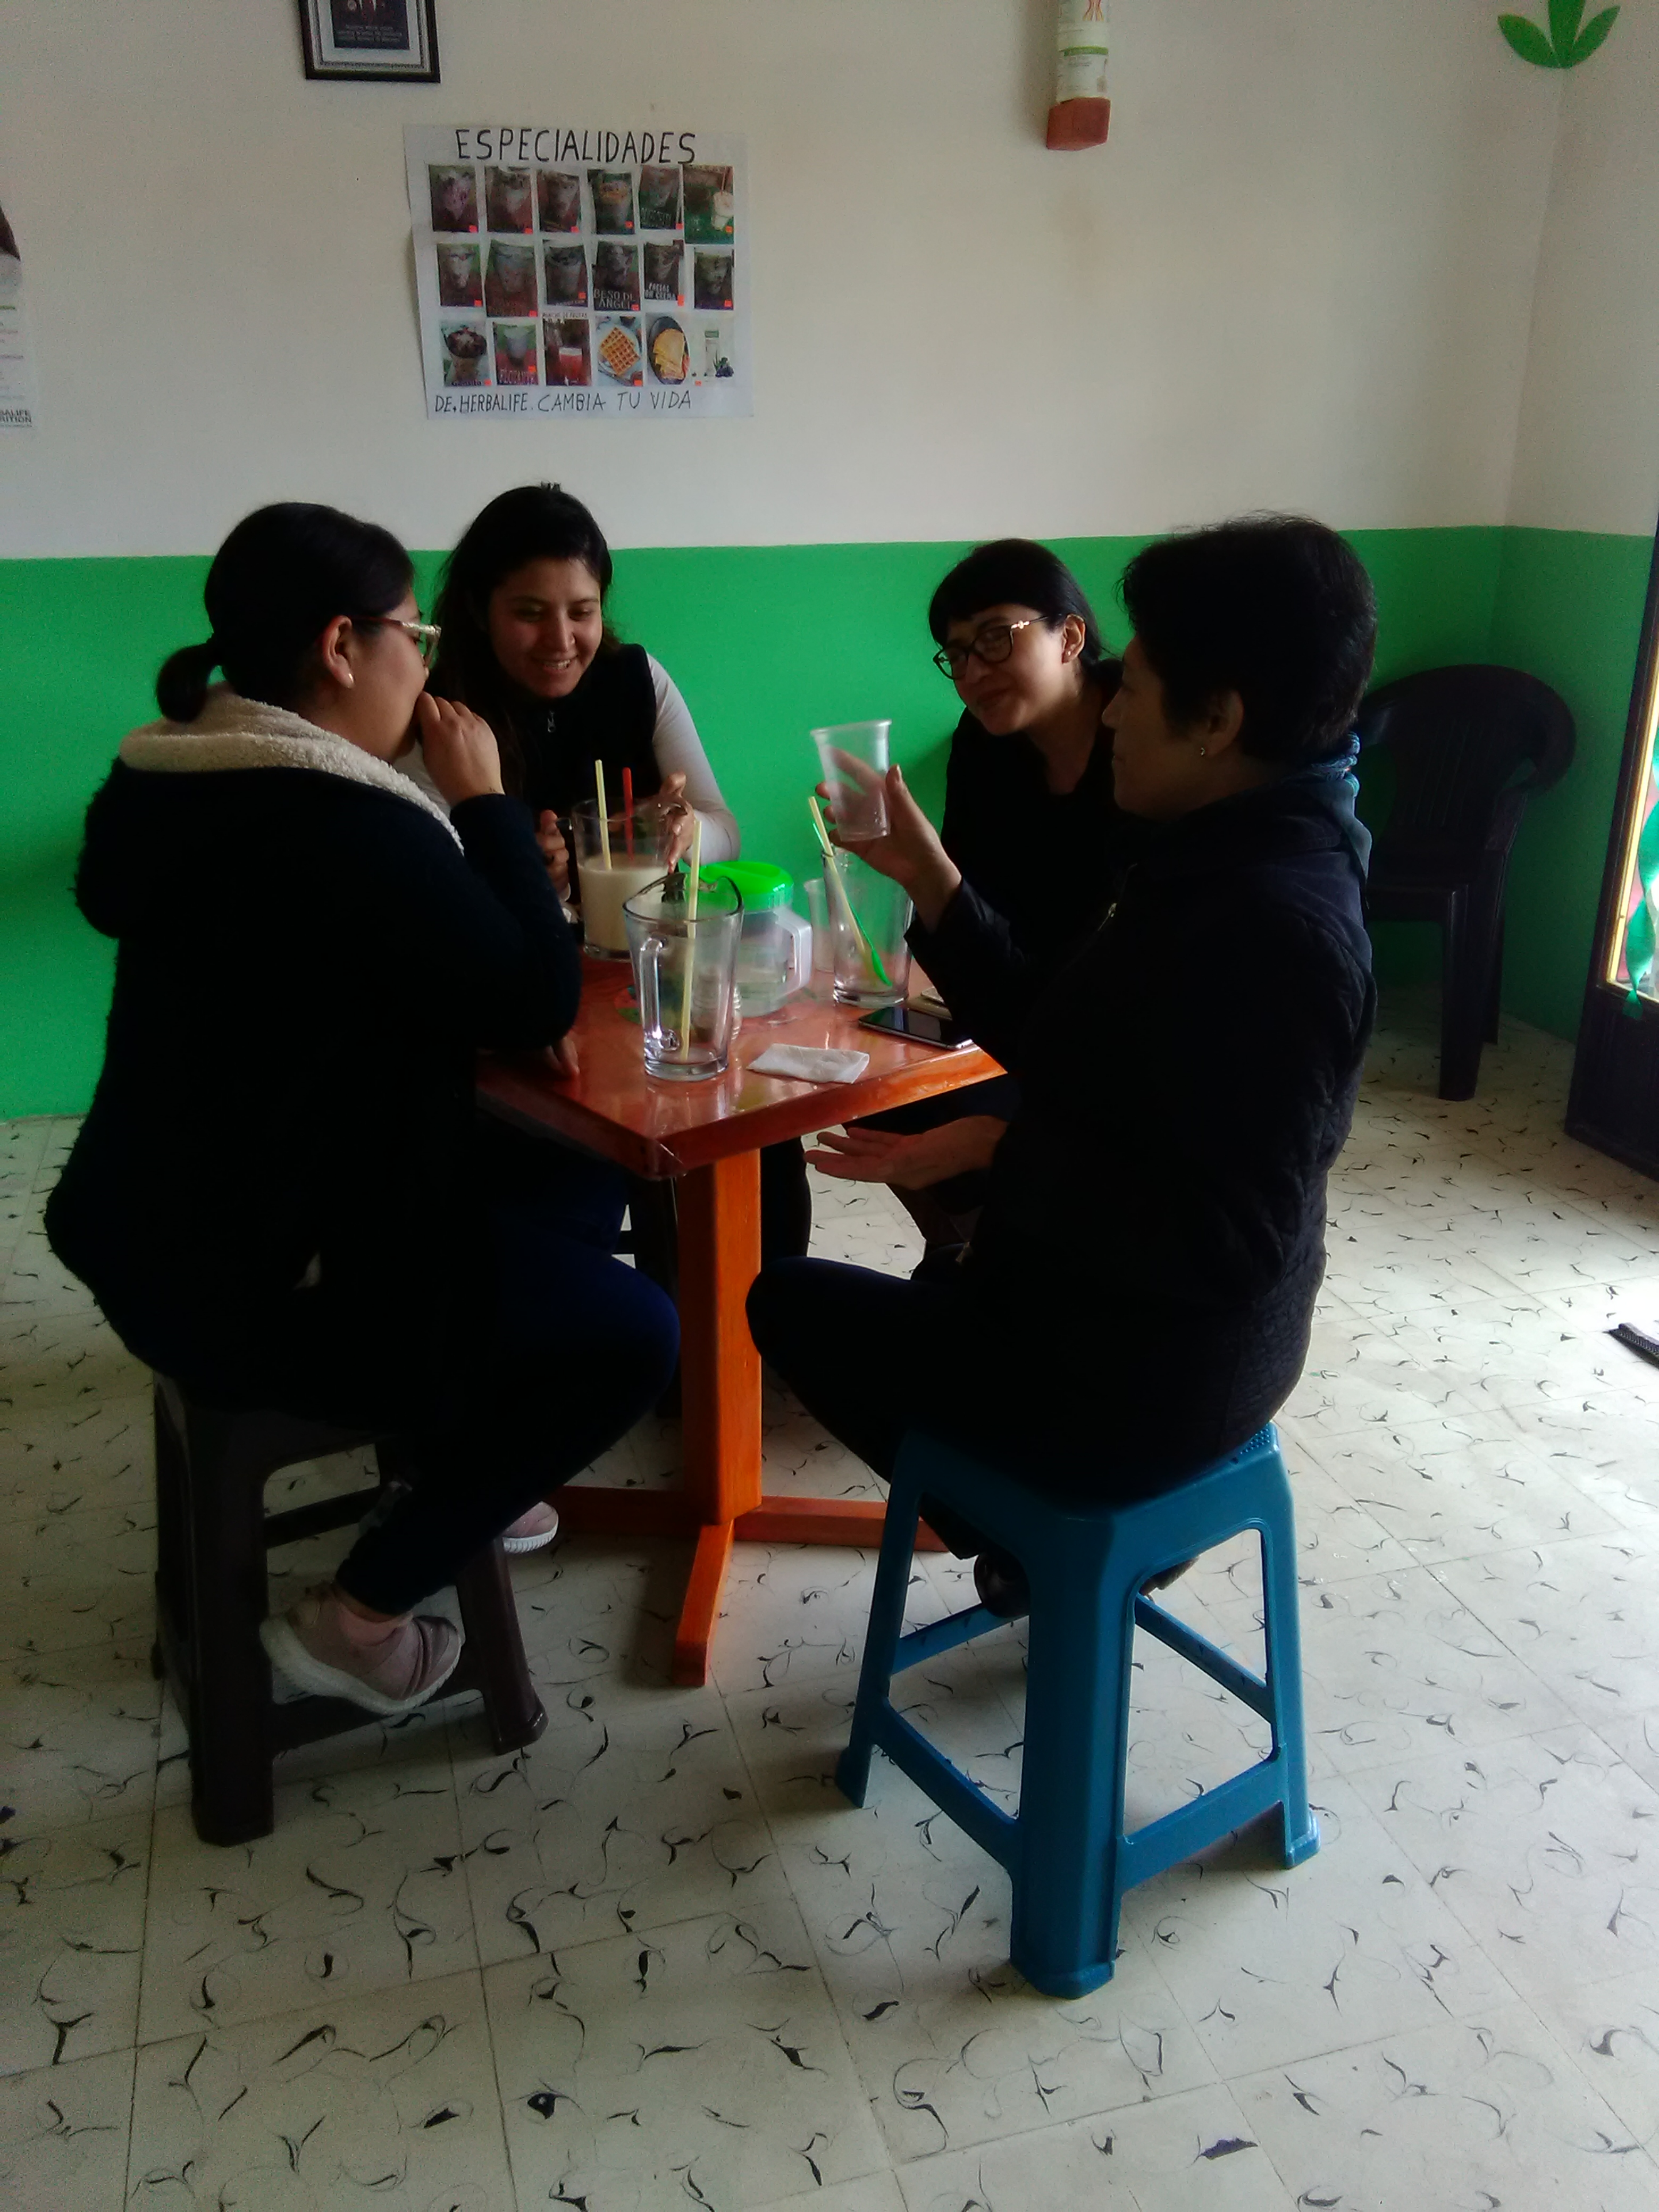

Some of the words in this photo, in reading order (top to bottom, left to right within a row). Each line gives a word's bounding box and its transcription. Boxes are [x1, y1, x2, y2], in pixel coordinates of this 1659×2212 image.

[455, 128, 696, 164] ESPECIALIDADES
[538, 392, 606, 412] CAMBIA
[617, 391, 641, 411] TU
[650, 390, 691, 410] VIDA
